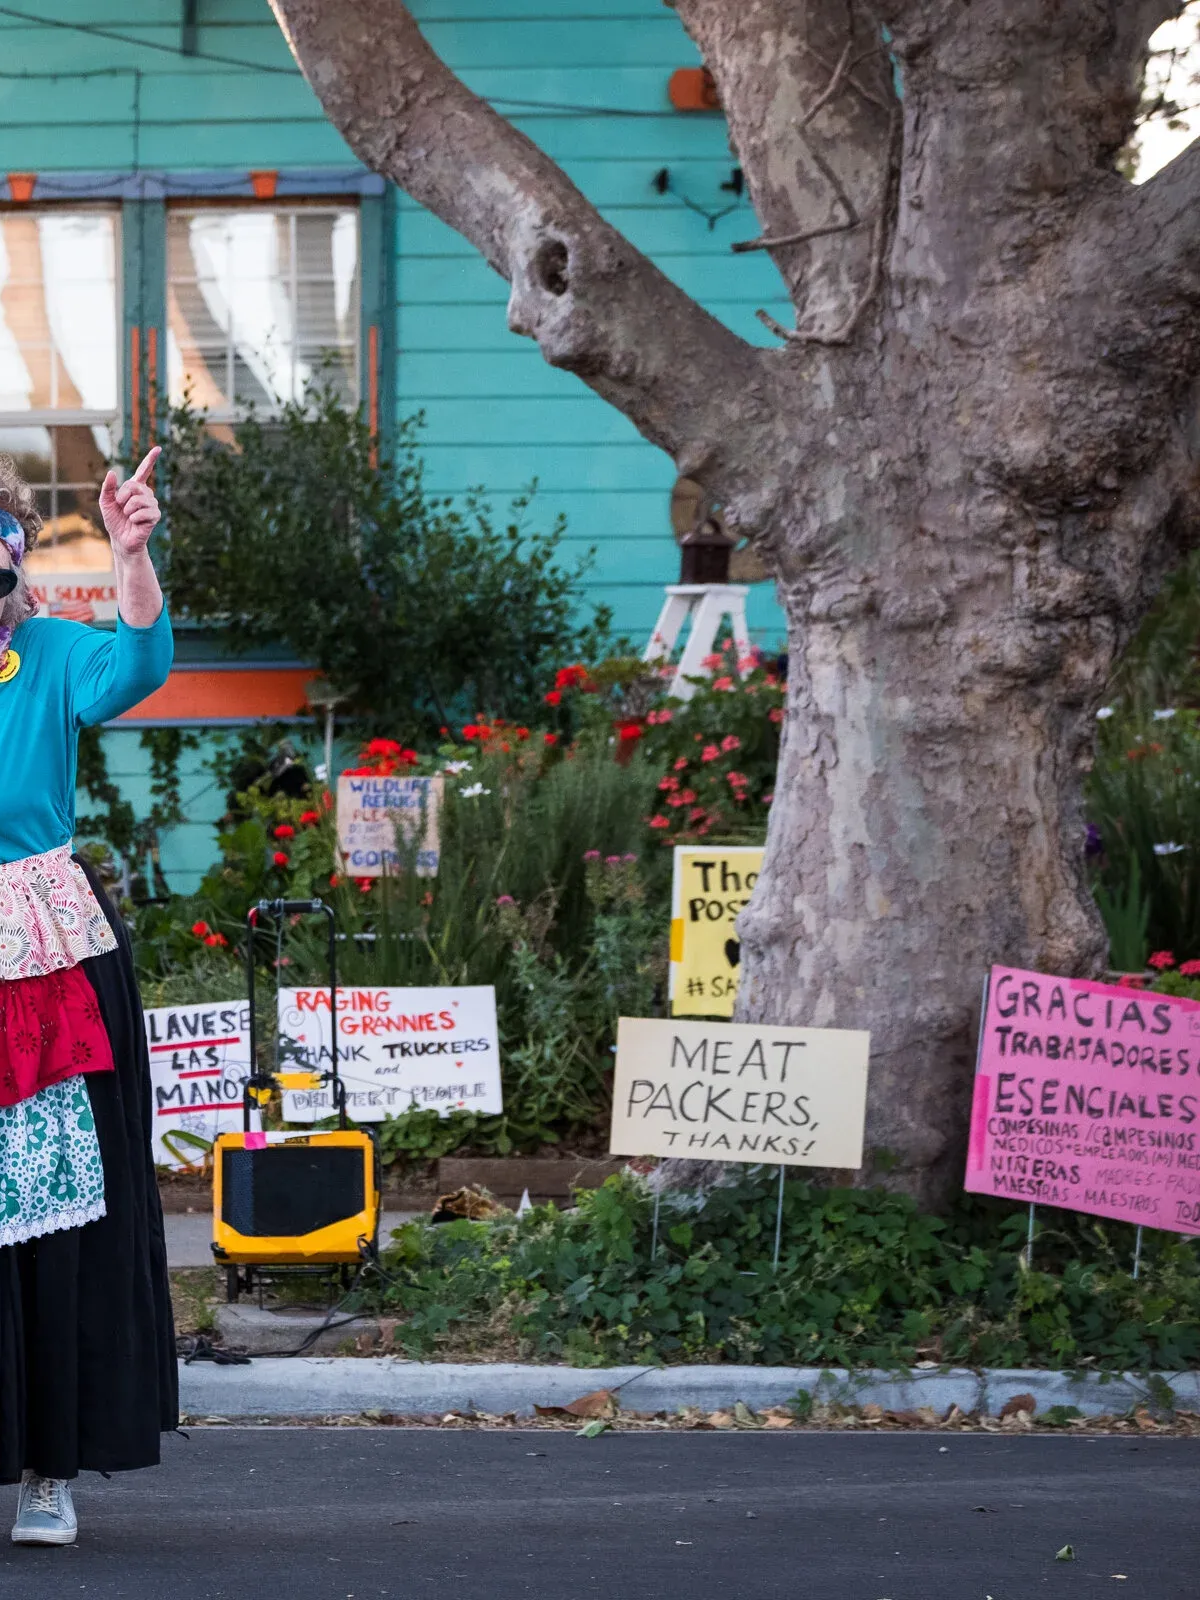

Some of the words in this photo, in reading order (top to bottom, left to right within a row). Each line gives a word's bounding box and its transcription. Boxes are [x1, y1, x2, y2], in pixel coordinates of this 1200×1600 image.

[296, 989, 392, 1013] RAGING
[995, 974, 1172, 1034] GRACIAS
[149, 1008, 250, 1043] LAVESE
[339, 1011, 456, 1036] GRANNIES
[171, 1045, 220, 1071] LAS
[382, 1037, 491, 1060] TRUCKERS
[670, 1035, 807, 1083] MEAT
[994, 1025, 1190, 1076] TRABAJADORES
[374, 1063, 401, 1076] and
[293, 1086, 399, 1110] DELVERY
[627, 1078, 820, 1132] PACKERS,
[993, 1072, 1199, 1125] ESENCIALES
[663, 1130, 817, 1157] THANKS!
[990, 1155, 1081, 1185] NIÑERAS
[993, 1173, 1070, 1202] MAESTRAS
